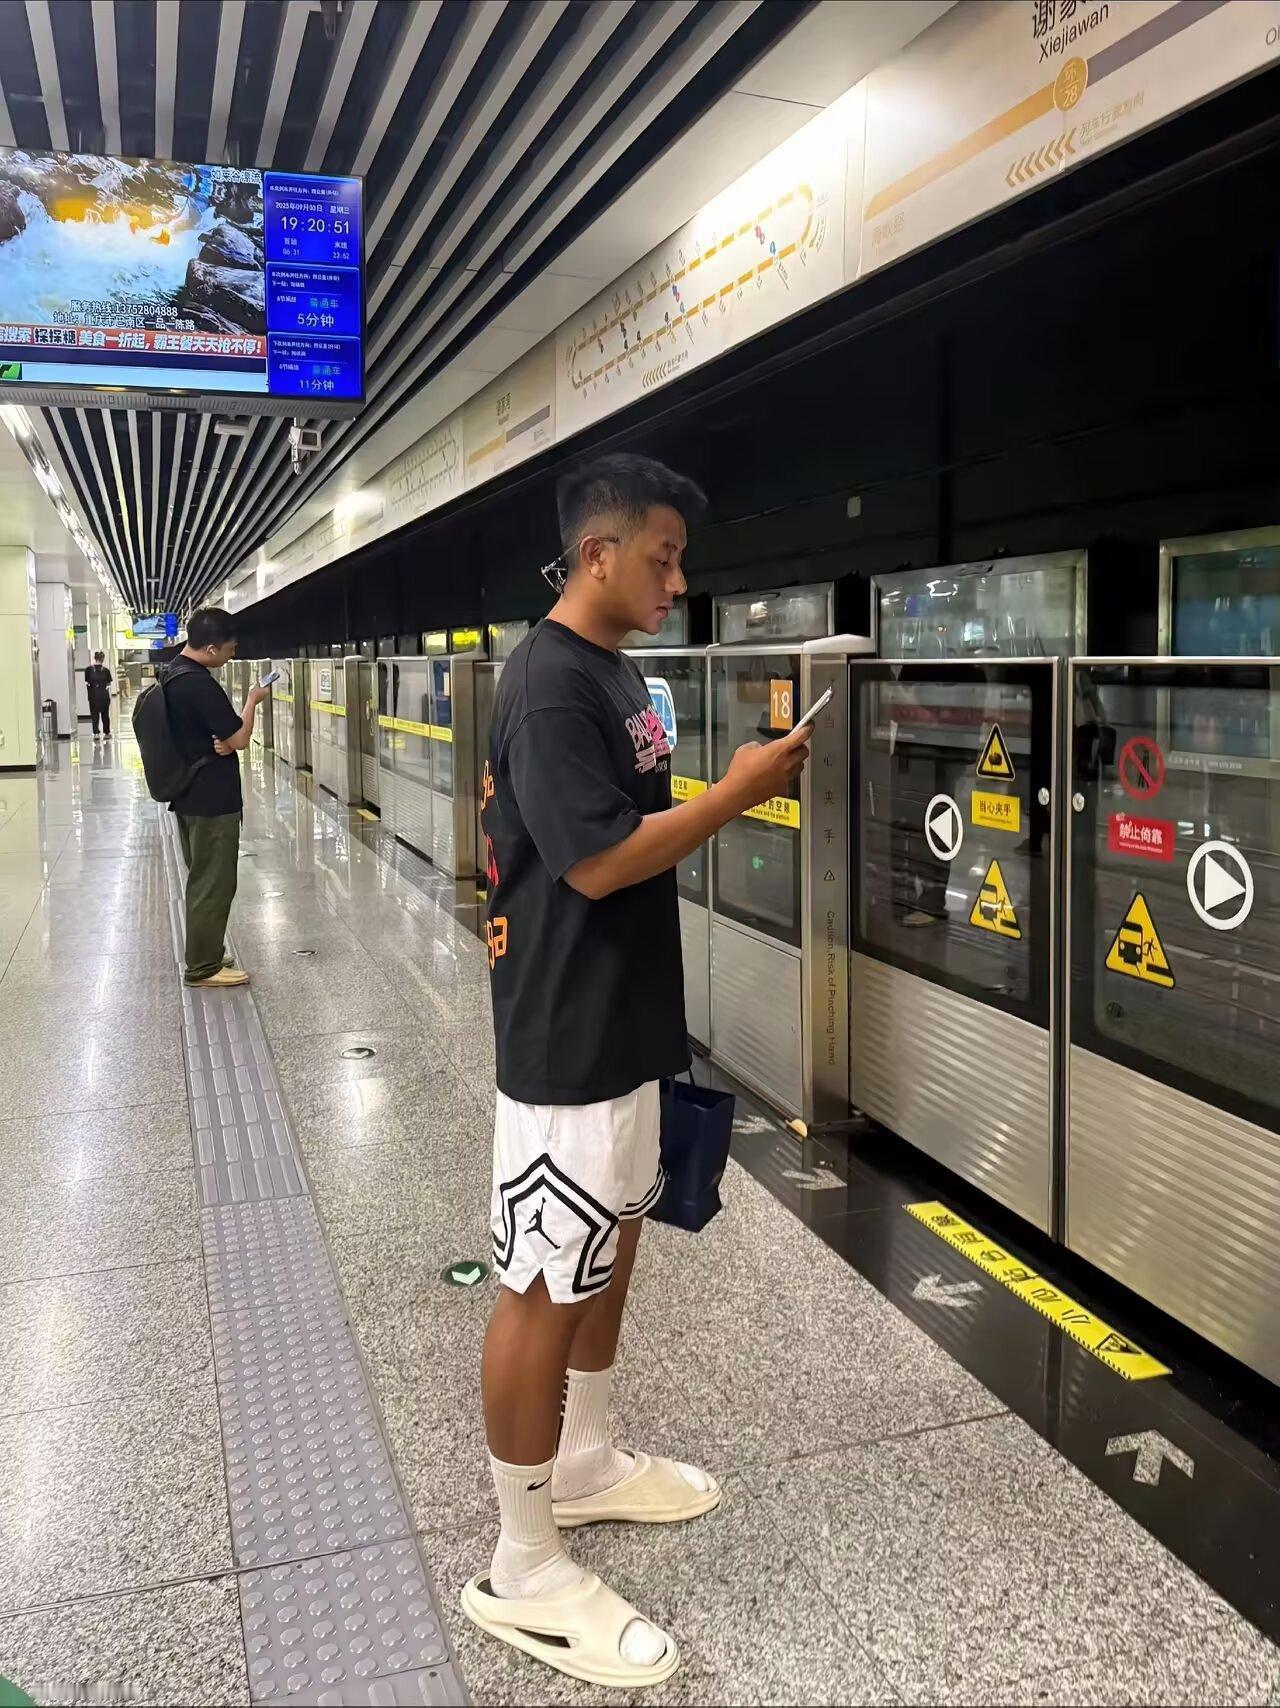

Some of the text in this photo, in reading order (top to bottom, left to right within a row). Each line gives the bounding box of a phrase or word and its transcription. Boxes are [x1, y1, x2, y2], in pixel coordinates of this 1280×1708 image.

[1039, 4, 1109, 64] Xiejiawan
[329, 205, 350, 215] 星期三
[281, 216, 349, 234] 19:20:51
[297, 313, 334, 327] 5分钟
[300, 379, 335, 391] 11分钟
[773, 690, 790, 719] 18
[980, 800, 1011, 816] 当心夹手
[1119, 822, 1163, 845] 禁止倚靠
[828, 977, 836, 987] of
[826, 989, 836, 1034] Pinching
[828, 1037, 836, 1065] Hand
